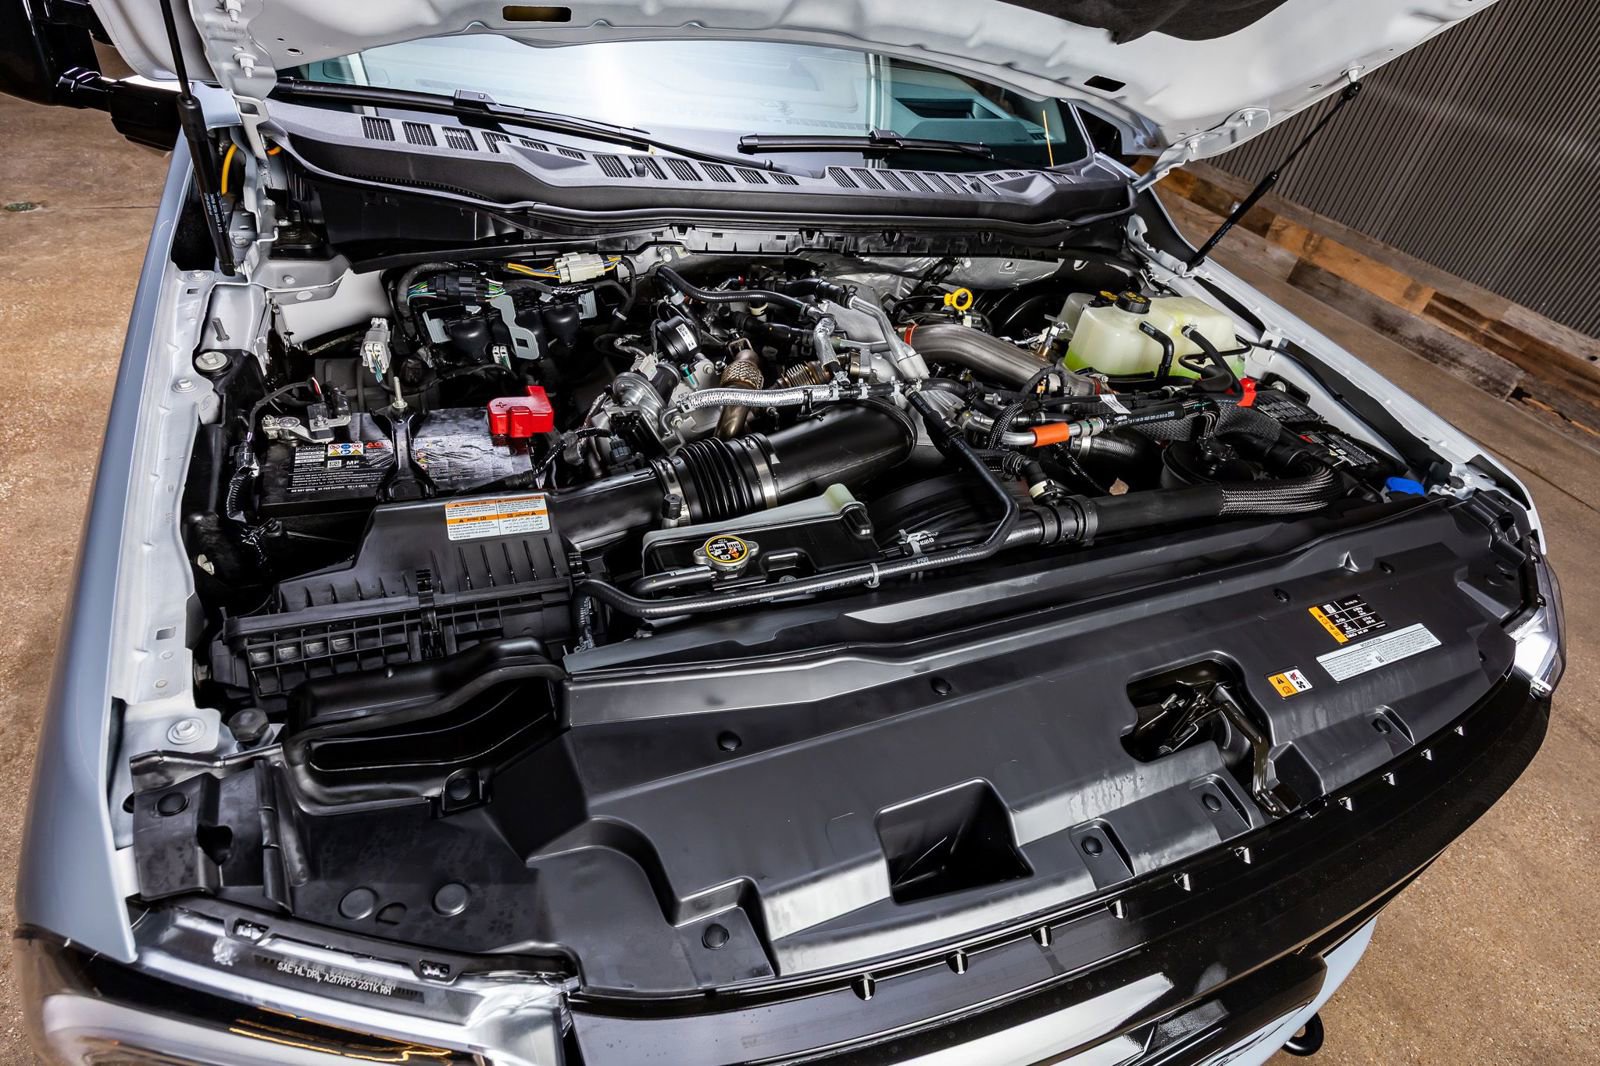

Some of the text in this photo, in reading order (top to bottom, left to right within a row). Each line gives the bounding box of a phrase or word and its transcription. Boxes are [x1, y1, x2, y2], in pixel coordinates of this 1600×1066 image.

[277, 961, 292, 974] SAE
[294, 965, 305, 977] HL
[380, 985, 393, 996] RH
